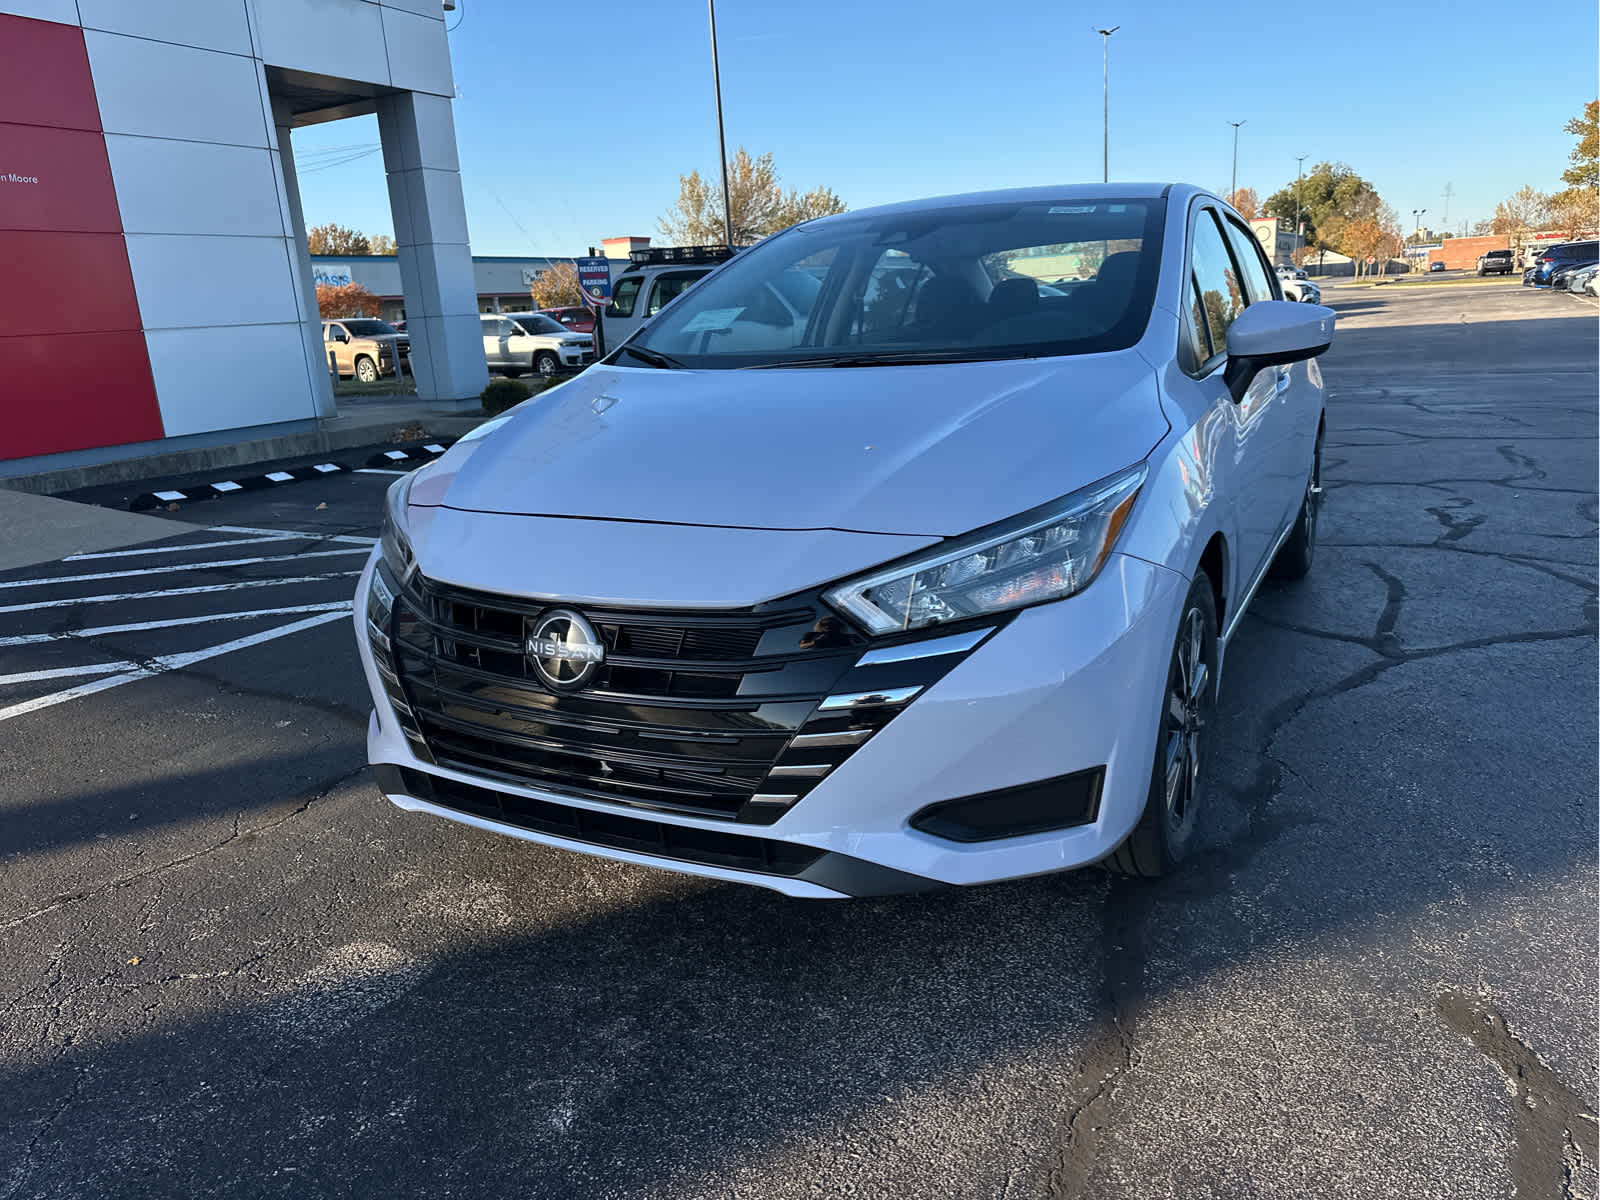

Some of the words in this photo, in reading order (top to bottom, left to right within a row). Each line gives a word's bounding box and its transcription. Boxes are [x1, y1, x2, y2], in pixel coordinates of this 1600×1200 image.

[8, 173, 38, 184] Moore
[579, 265, 609, 273] RESERVED
[528, 639, 601, 660] NISSAN
